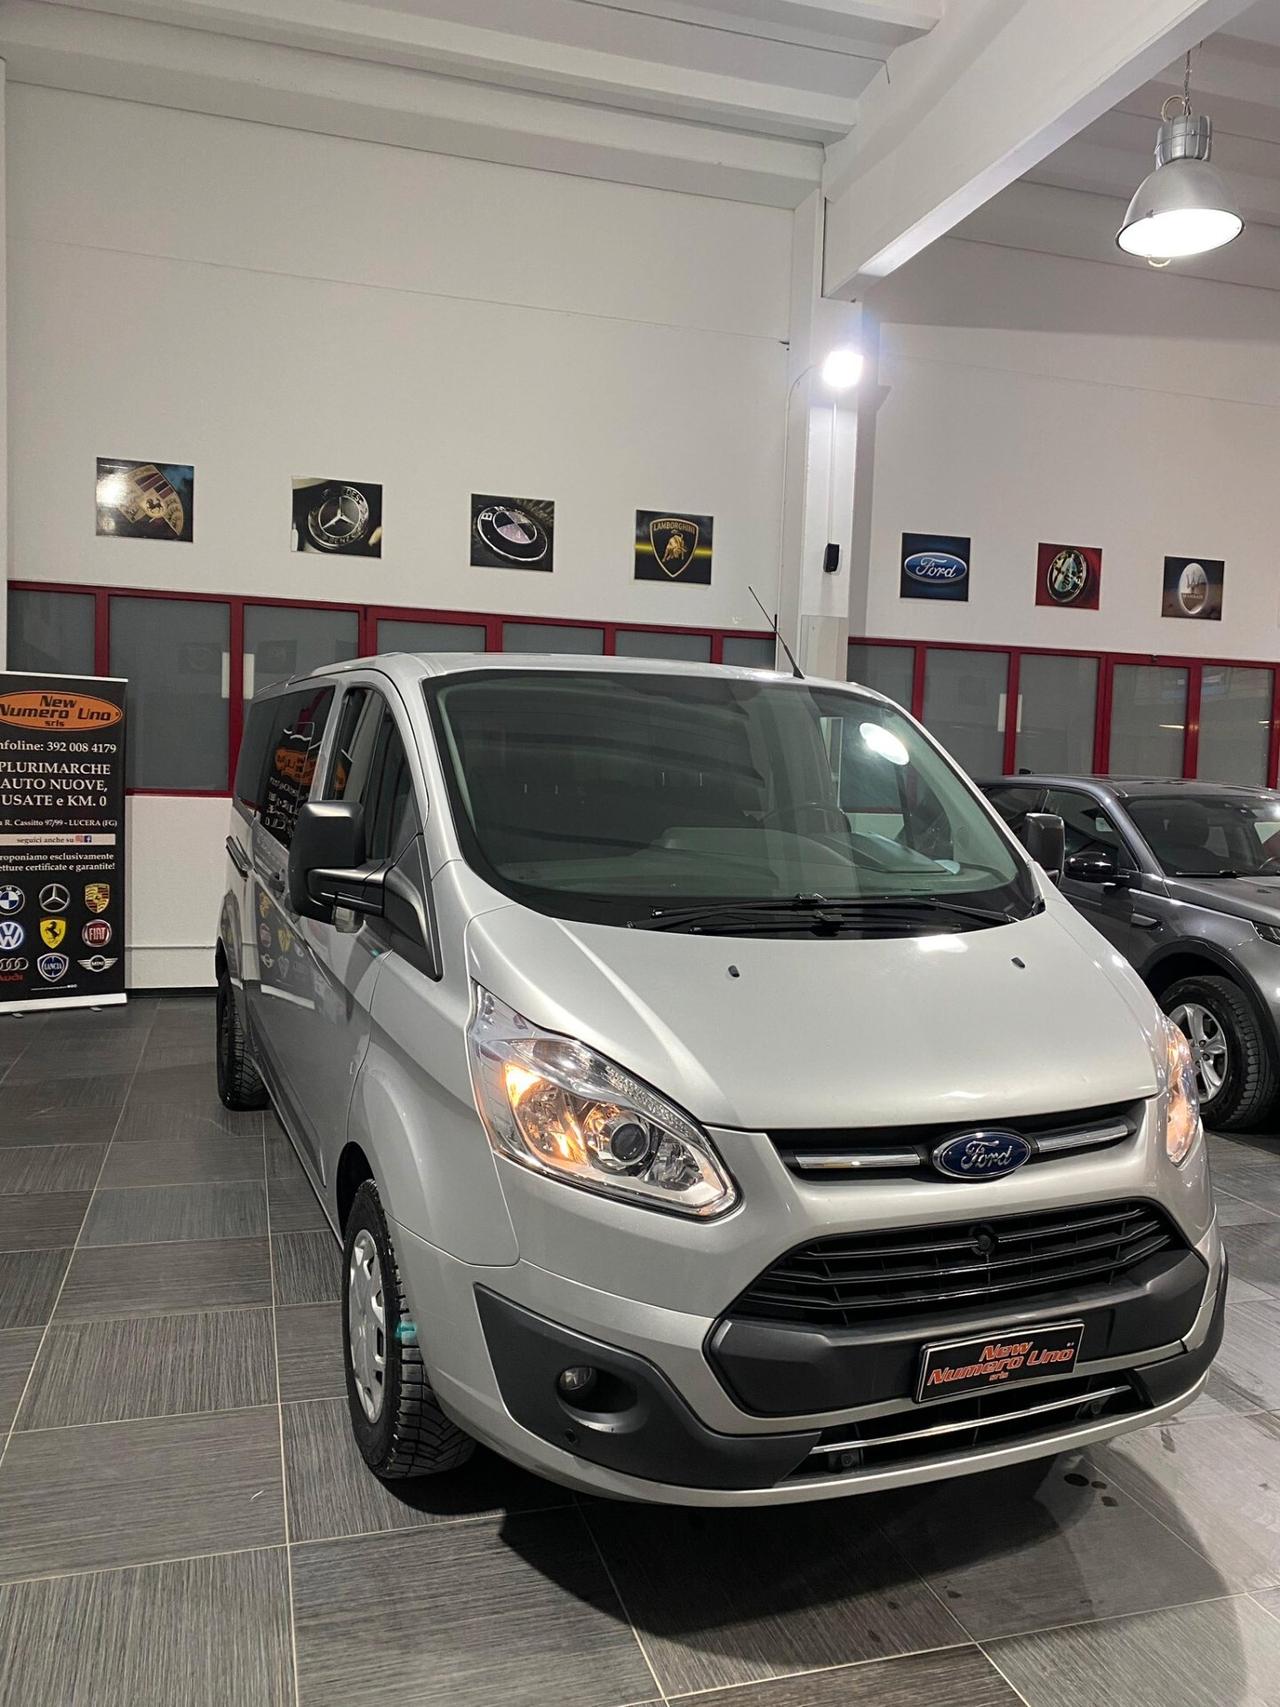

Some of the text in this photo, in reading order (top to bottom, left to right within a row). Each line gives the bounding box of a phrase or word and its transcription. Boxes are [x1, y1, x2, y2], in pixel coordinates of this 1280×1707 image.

[915, 556, 957, 578] Ford
[40, 695, 77, 708] New
[0, 703, 111, 721] Numero Uno
[46, 742, 67, 752] 392
[69, 742, 89, 752] 008
[91, 743, 117, 754] 4179
[0, 761, 111, 775] PLURIMARCHE
[0, 778, 108, 792] AUTO NUOVE,
[1, 794, 107, 806] USATE e KM. 0
[16, 836, 42, 844] seguici
[50, 852, 114, 860] esclusivamente
[25, 863, 68, 871] certificate
[75, 862, 115, 872] garantite!
[89, 927, 106, 940] FIAT
[960, 1139, 1013, 1170] Ford
[979, 1341, 1034, 1361] New
[927, 1349, 1074, 1385] Numero Uno
